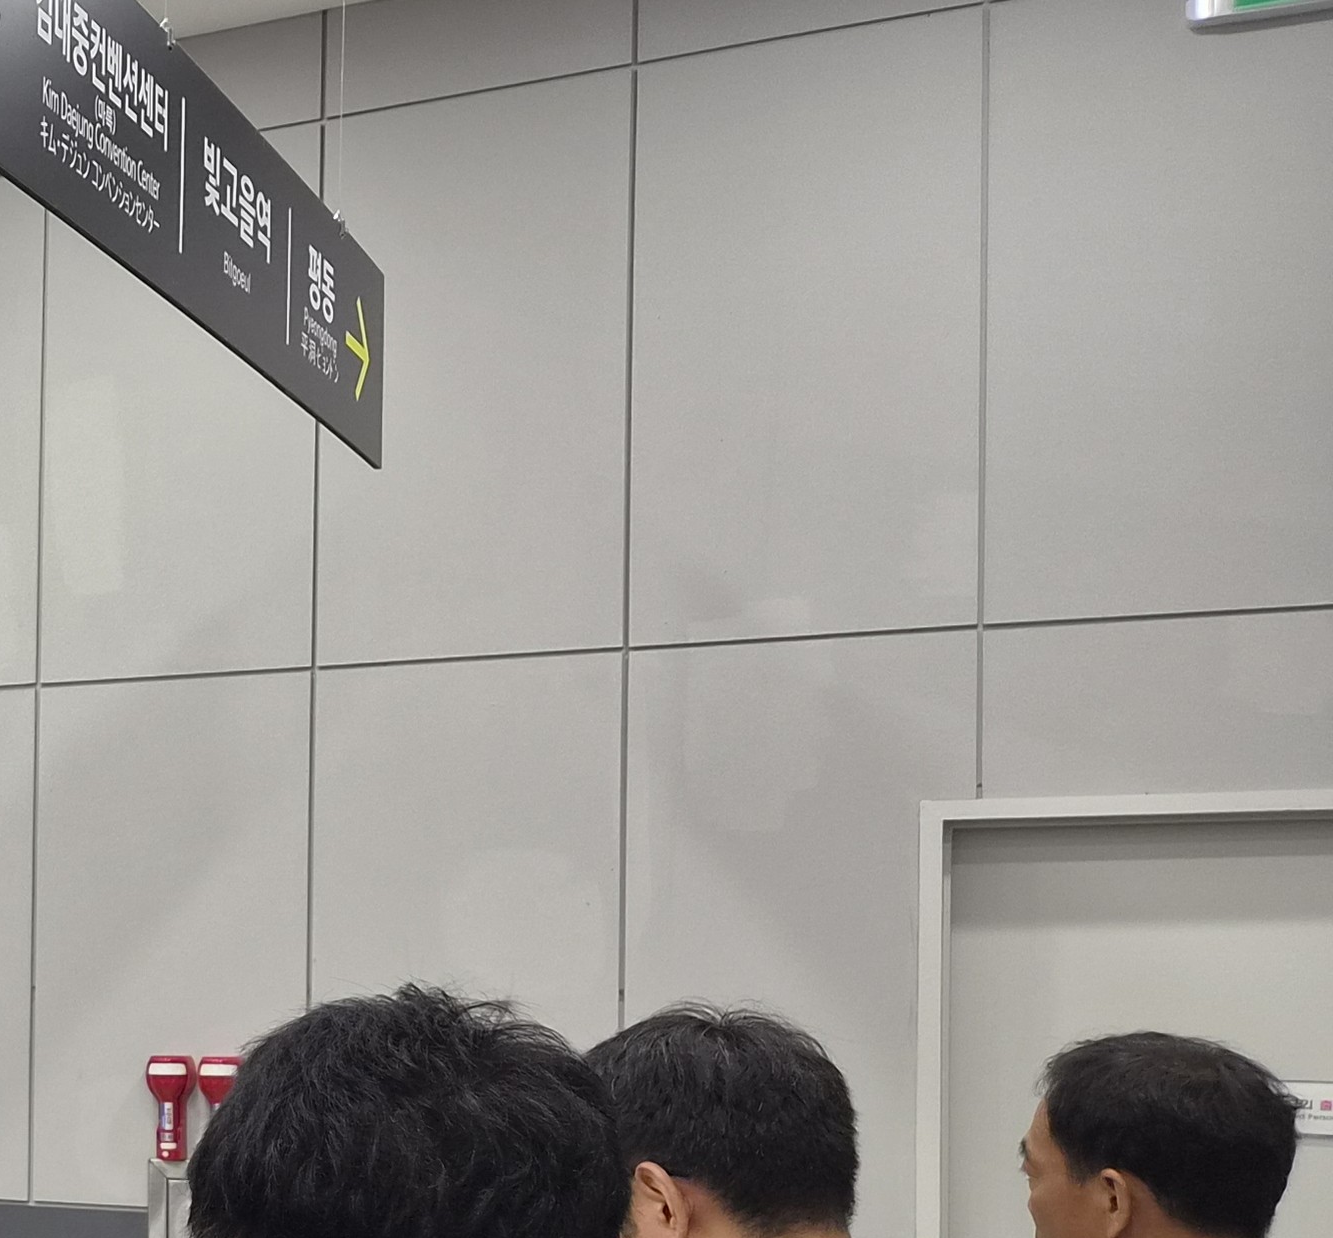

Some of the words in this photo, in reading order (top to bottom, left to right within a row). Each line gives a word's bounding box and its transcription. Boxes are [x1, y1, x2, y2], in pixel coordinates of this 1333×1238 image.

[42, 76, 59, 115] Kim
[61, 91, 94, 149] Daejung
[95, 123, 137, 181] Convention
[137, 160, 161, 200] Center
[204, 136, 271, 264] 빛고을역
[224, 251, 251, 294] Bitgoeul
[308, 244, 336, 324] 평동
[304, 306, 337, 365] Pyeongdong
